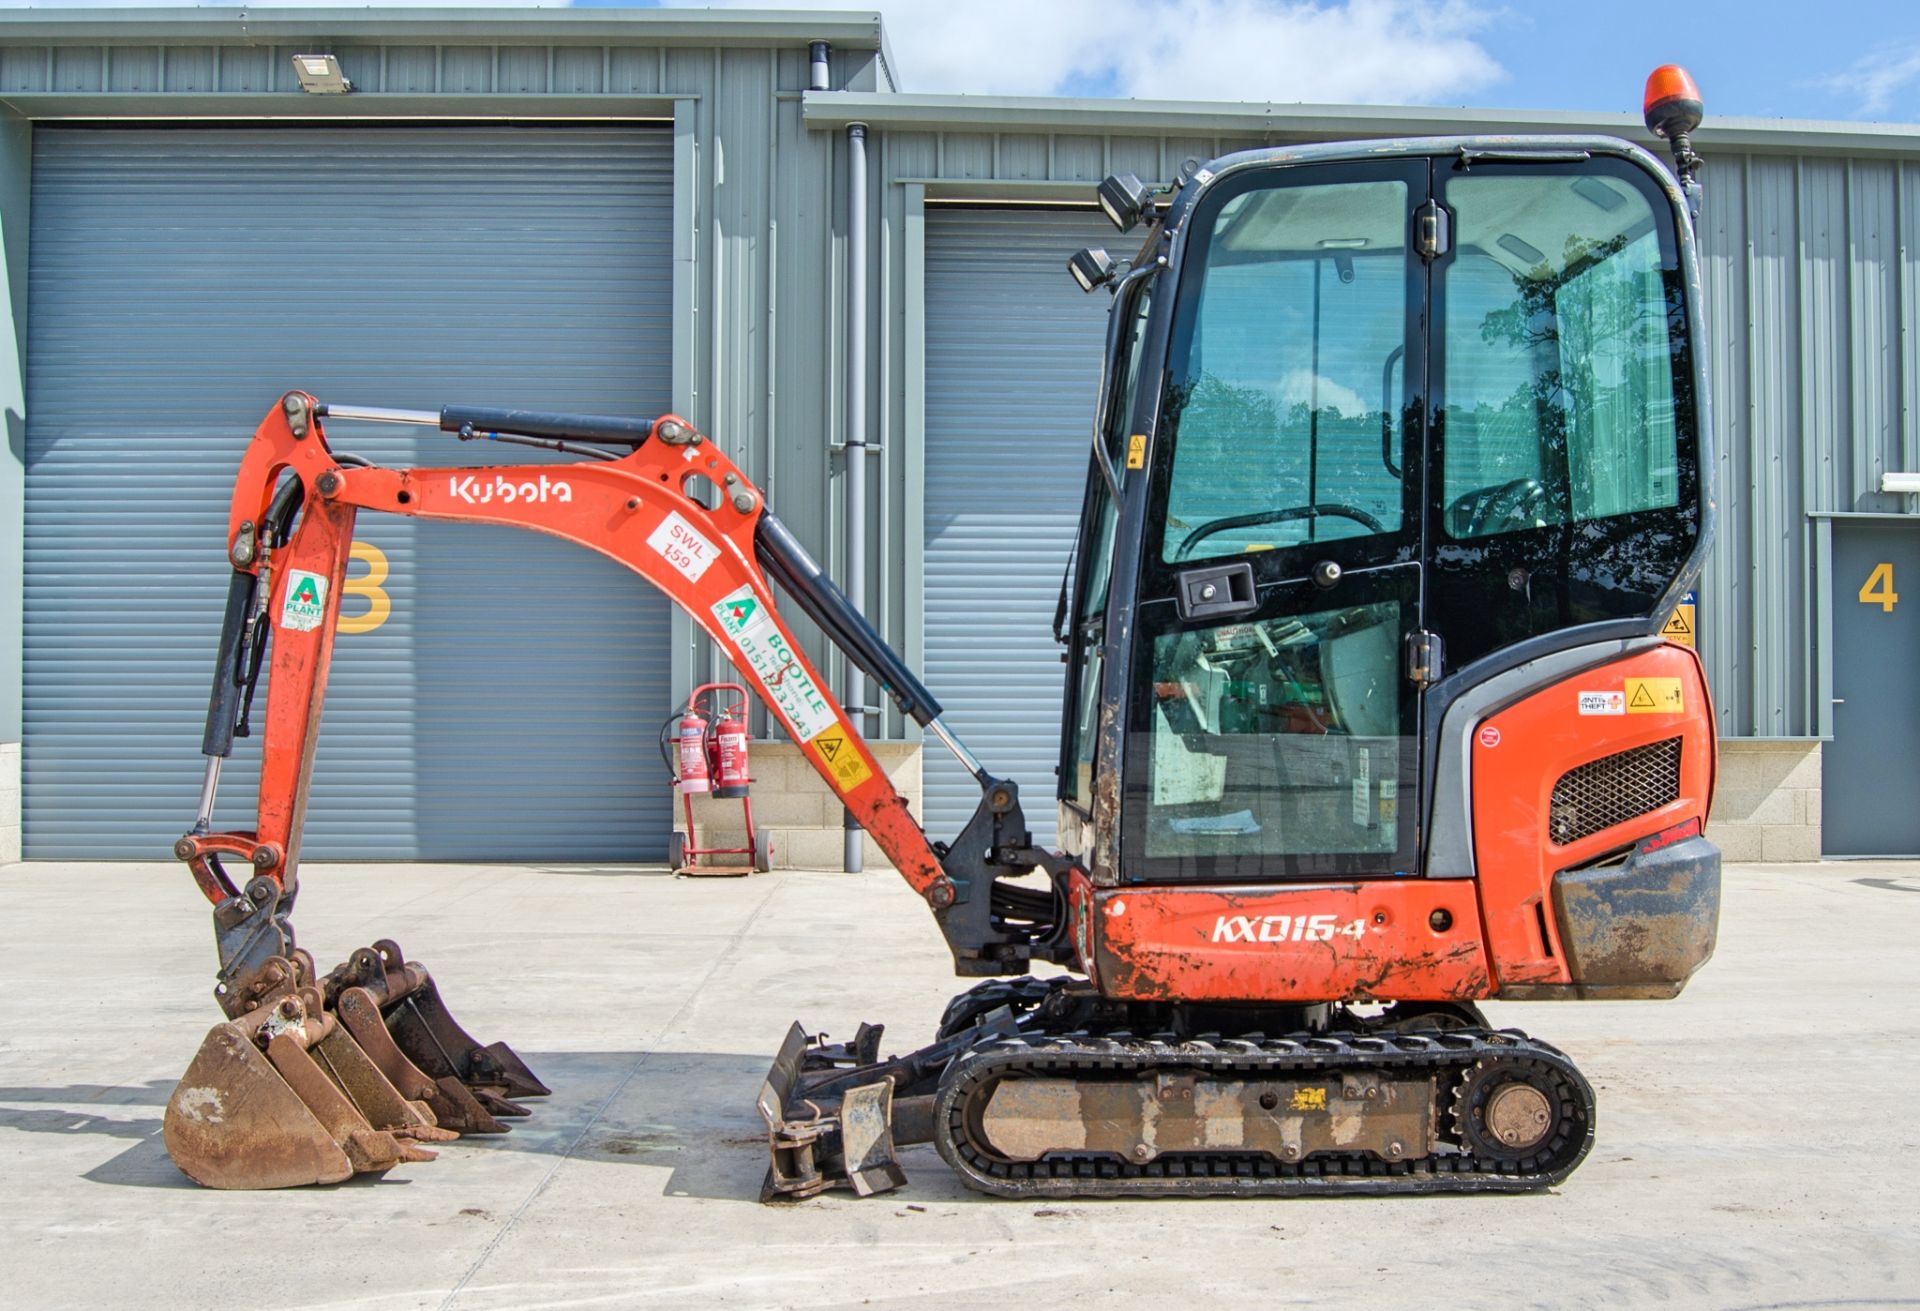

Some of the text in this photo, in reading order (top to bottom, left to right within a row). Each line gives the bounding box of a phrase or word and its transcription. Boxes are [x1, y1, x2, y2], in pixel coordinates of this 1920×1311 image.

[450, 474, 573, 504] Kubota
[663, 543, 691, 569] 159
[670, 524, 703, 560] SWL
[290, 576, 321, 606] A
[1858, 562, 1899, 613] 4
[285, 602, 322, 616] PLANT
[716, 604, 740, 636] PLANT
[725, 597, 757, 628] A
[768, 633, 826, 716] BOOTLE
[783, 702, 812, 739] 2343
[1581, 703, 1606, 711] THEFT
